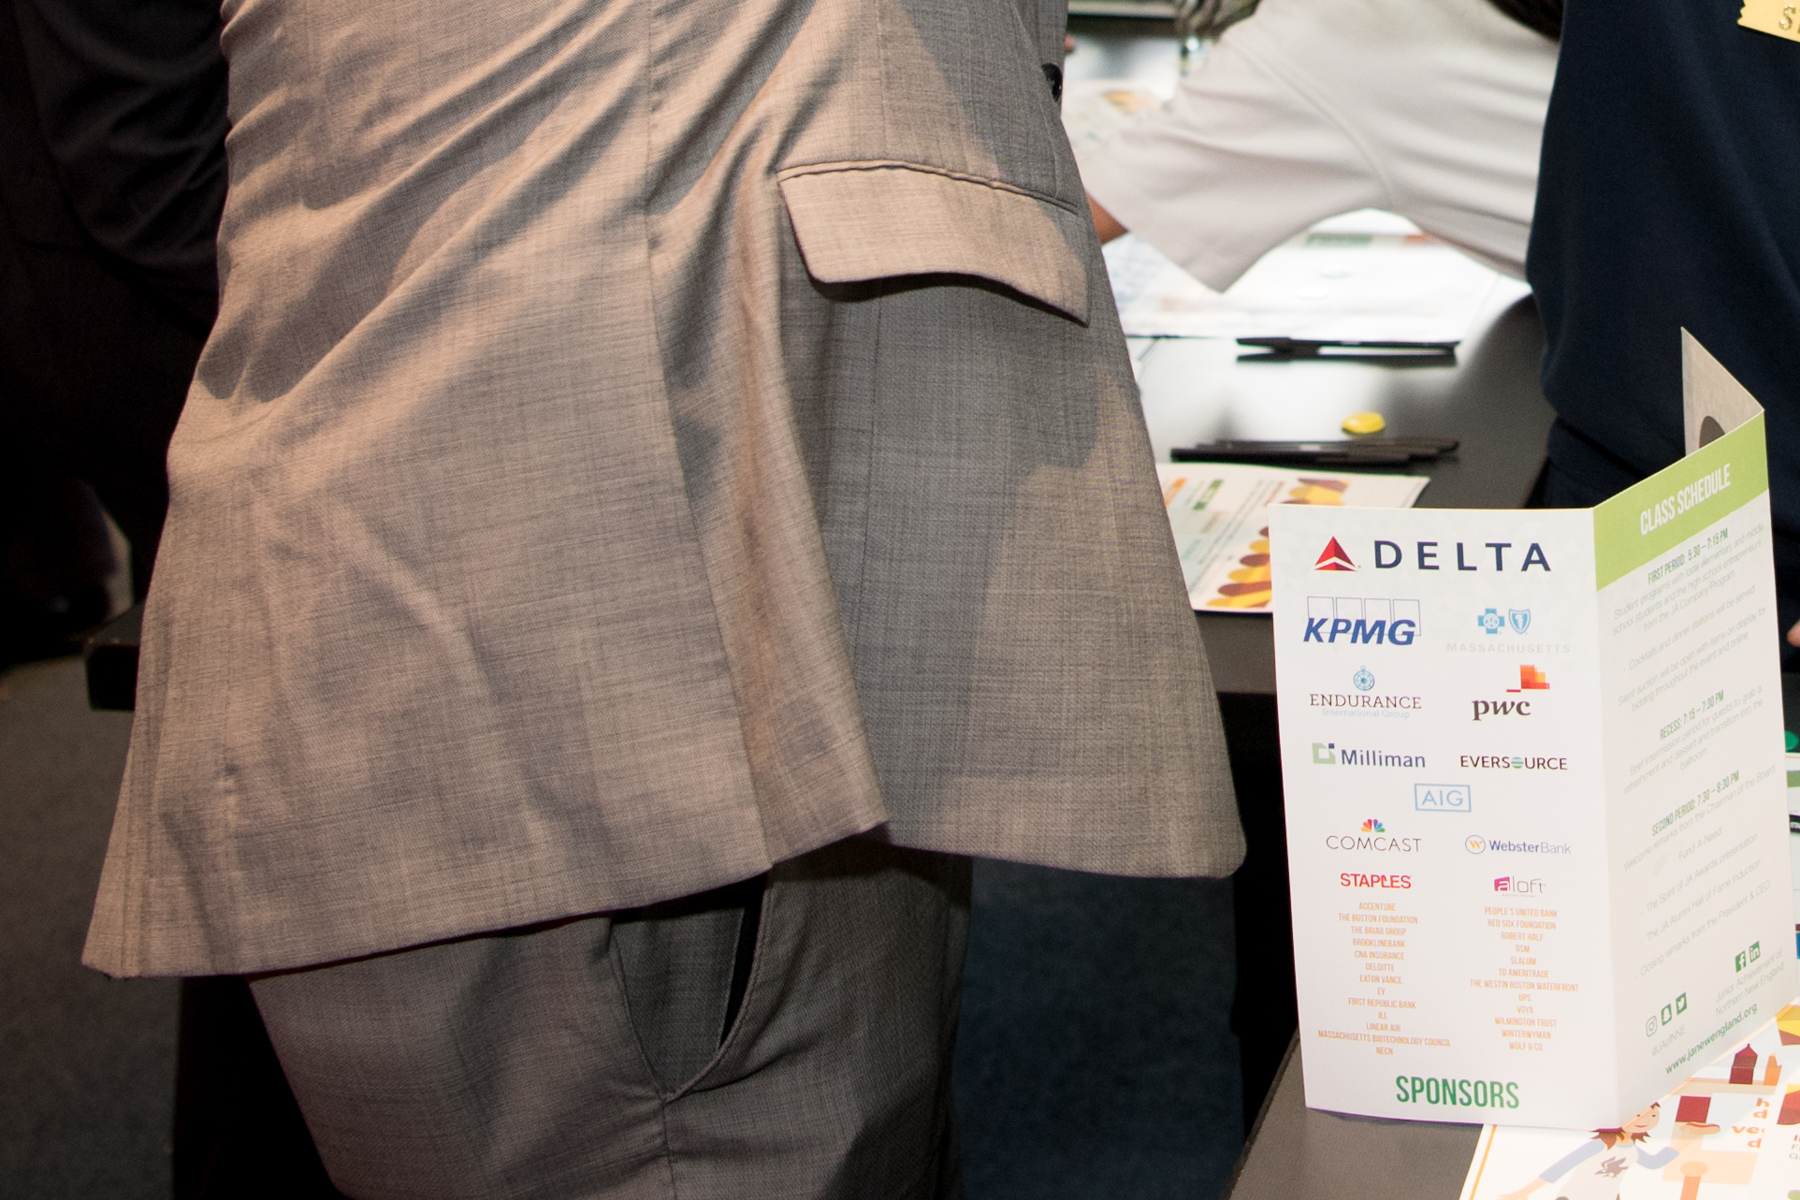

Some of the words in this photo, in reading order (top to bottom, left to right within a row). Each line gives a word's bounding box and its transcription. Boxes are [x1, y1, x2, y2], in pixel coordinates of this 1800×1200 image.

[1640, 495, 1675, 536] CLASS
[1677, 462, 1731, 515] SCHEDULE
[1374, 540, 1551, 572] DELTA
[1303, 617, 1416, 646] KPMG
[1446, 642, 1571, 654] MASSACHUSETTS
[1309, 693, 1422, 710] ENDURANCE
[1472, 699, 1531, 721] pwc
[1322, 708, 1380, 718] International
[1382, 709, 1410, 720] Group
[1341, 749, 1426, 768] Milliman
[1460, 755, 1568, 771] EVERSOURCE
[1421, 790, 1464, 807] AIG
[1326, 835, 1422, 852] COMCAST
[1340, 872, 1412, 889] STAPLES
[1665, 1003, 1758, 1074] www.janewengland.org
[1395, 1075, 1520, 1109] SPONSORS
